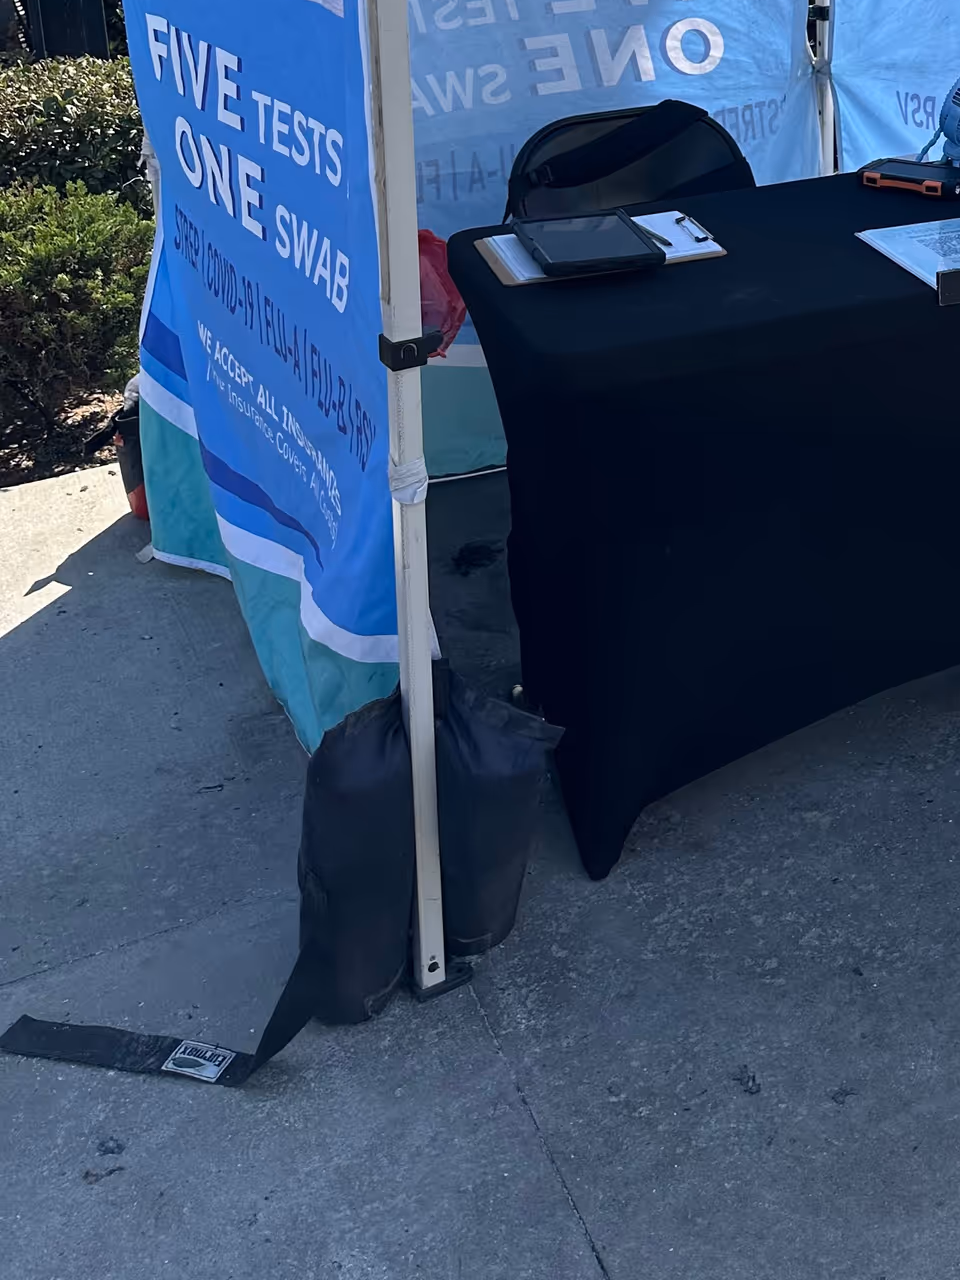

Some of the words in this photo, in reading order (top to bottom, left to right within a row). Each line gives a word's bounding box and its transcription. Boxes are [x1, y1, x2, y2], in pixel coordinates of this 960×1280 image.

[145, 13, 243, 132] FIVE
[252, 90, 344, 187] TESTS
[174, 116, 266, 241] ONE
[275, 204, 350, 313] SWAB
[174, 203, 199, 272] STREP
[207, 242, 254, 330] COVID-19
[264, 296, 301, 383] FLU-A
[310, 342, 347, 436] FLU-B
[197, 320, 212, 355] WE
[214, 340, 254, 395] ACCEPT
[257, 384, 279, 422] ALL
[227, 383, 275, 444] Insurance
[276, 431, 307, 482] Covers
